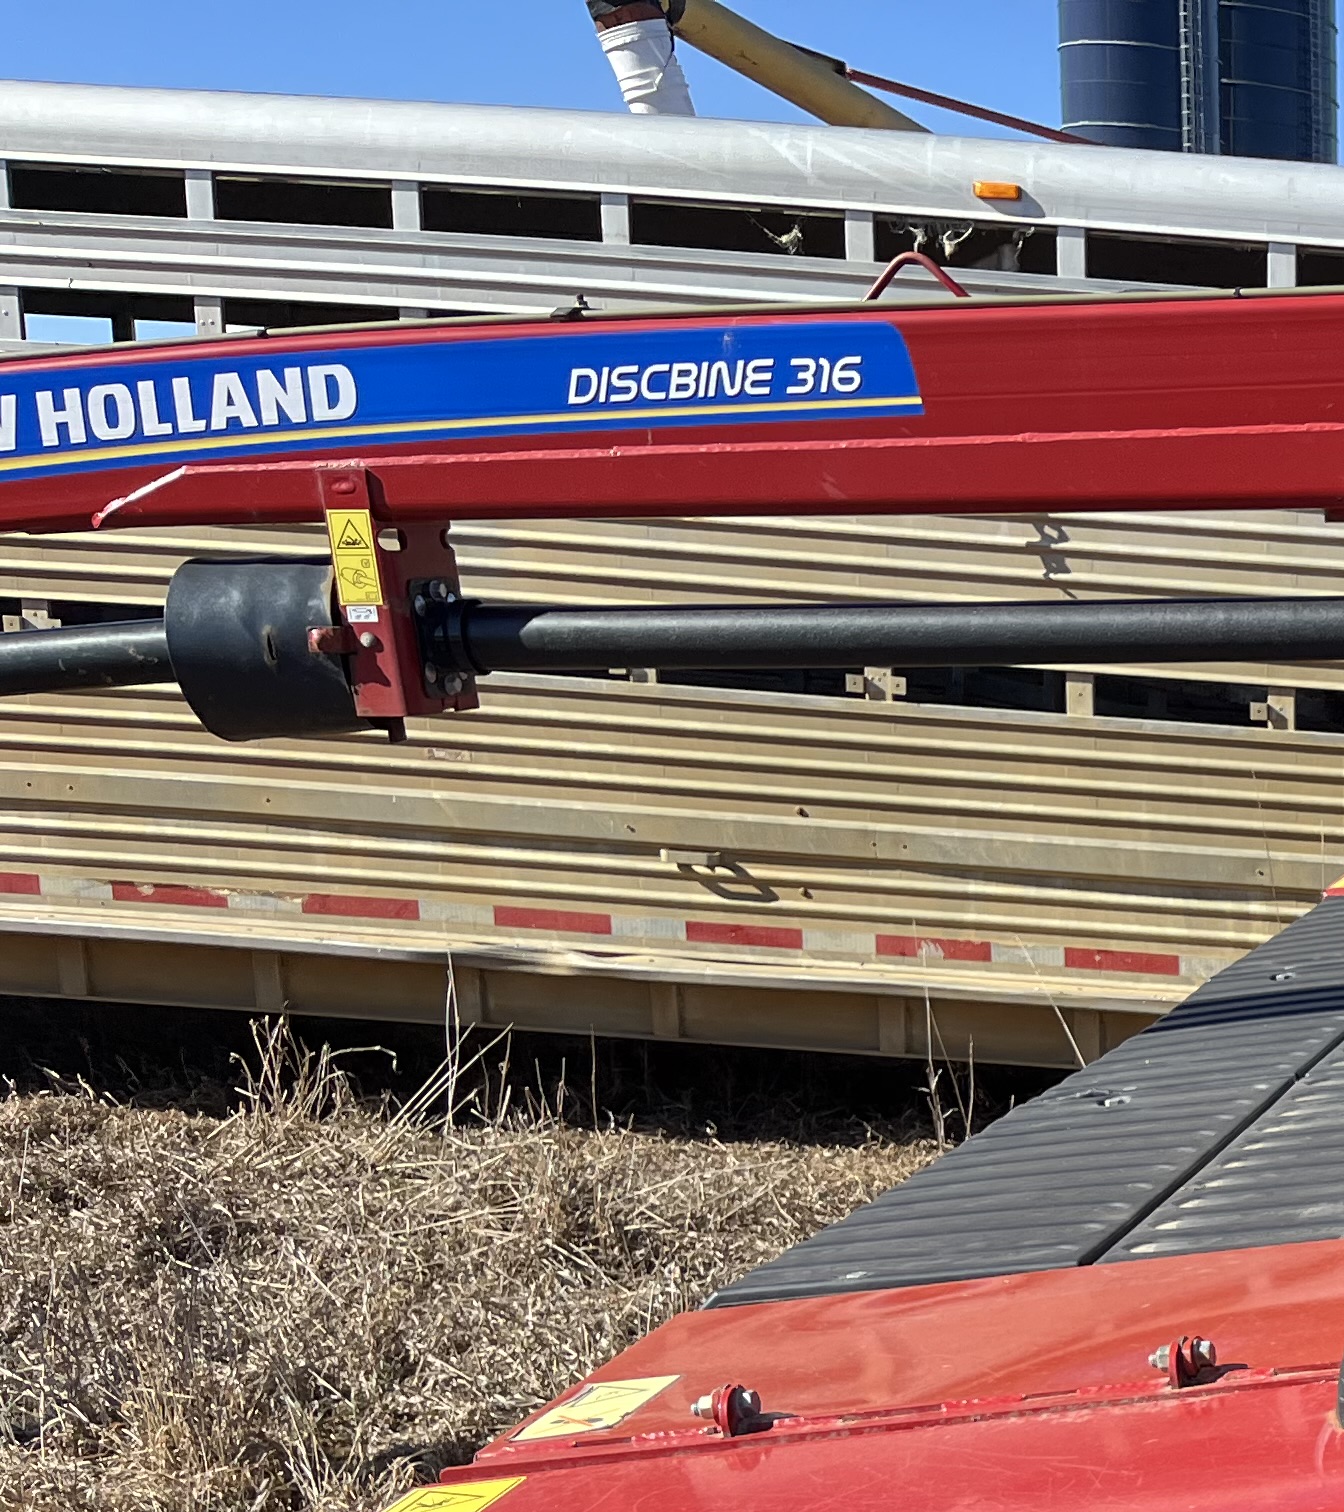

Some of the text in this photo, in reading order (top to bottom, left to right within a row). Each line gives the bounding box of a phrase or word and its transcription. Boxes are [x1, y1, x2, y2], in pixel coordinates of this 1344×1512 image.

[35, 364, 358, 447] HOLLAND
[567, 354, 863, 405] DISCBINE 316
